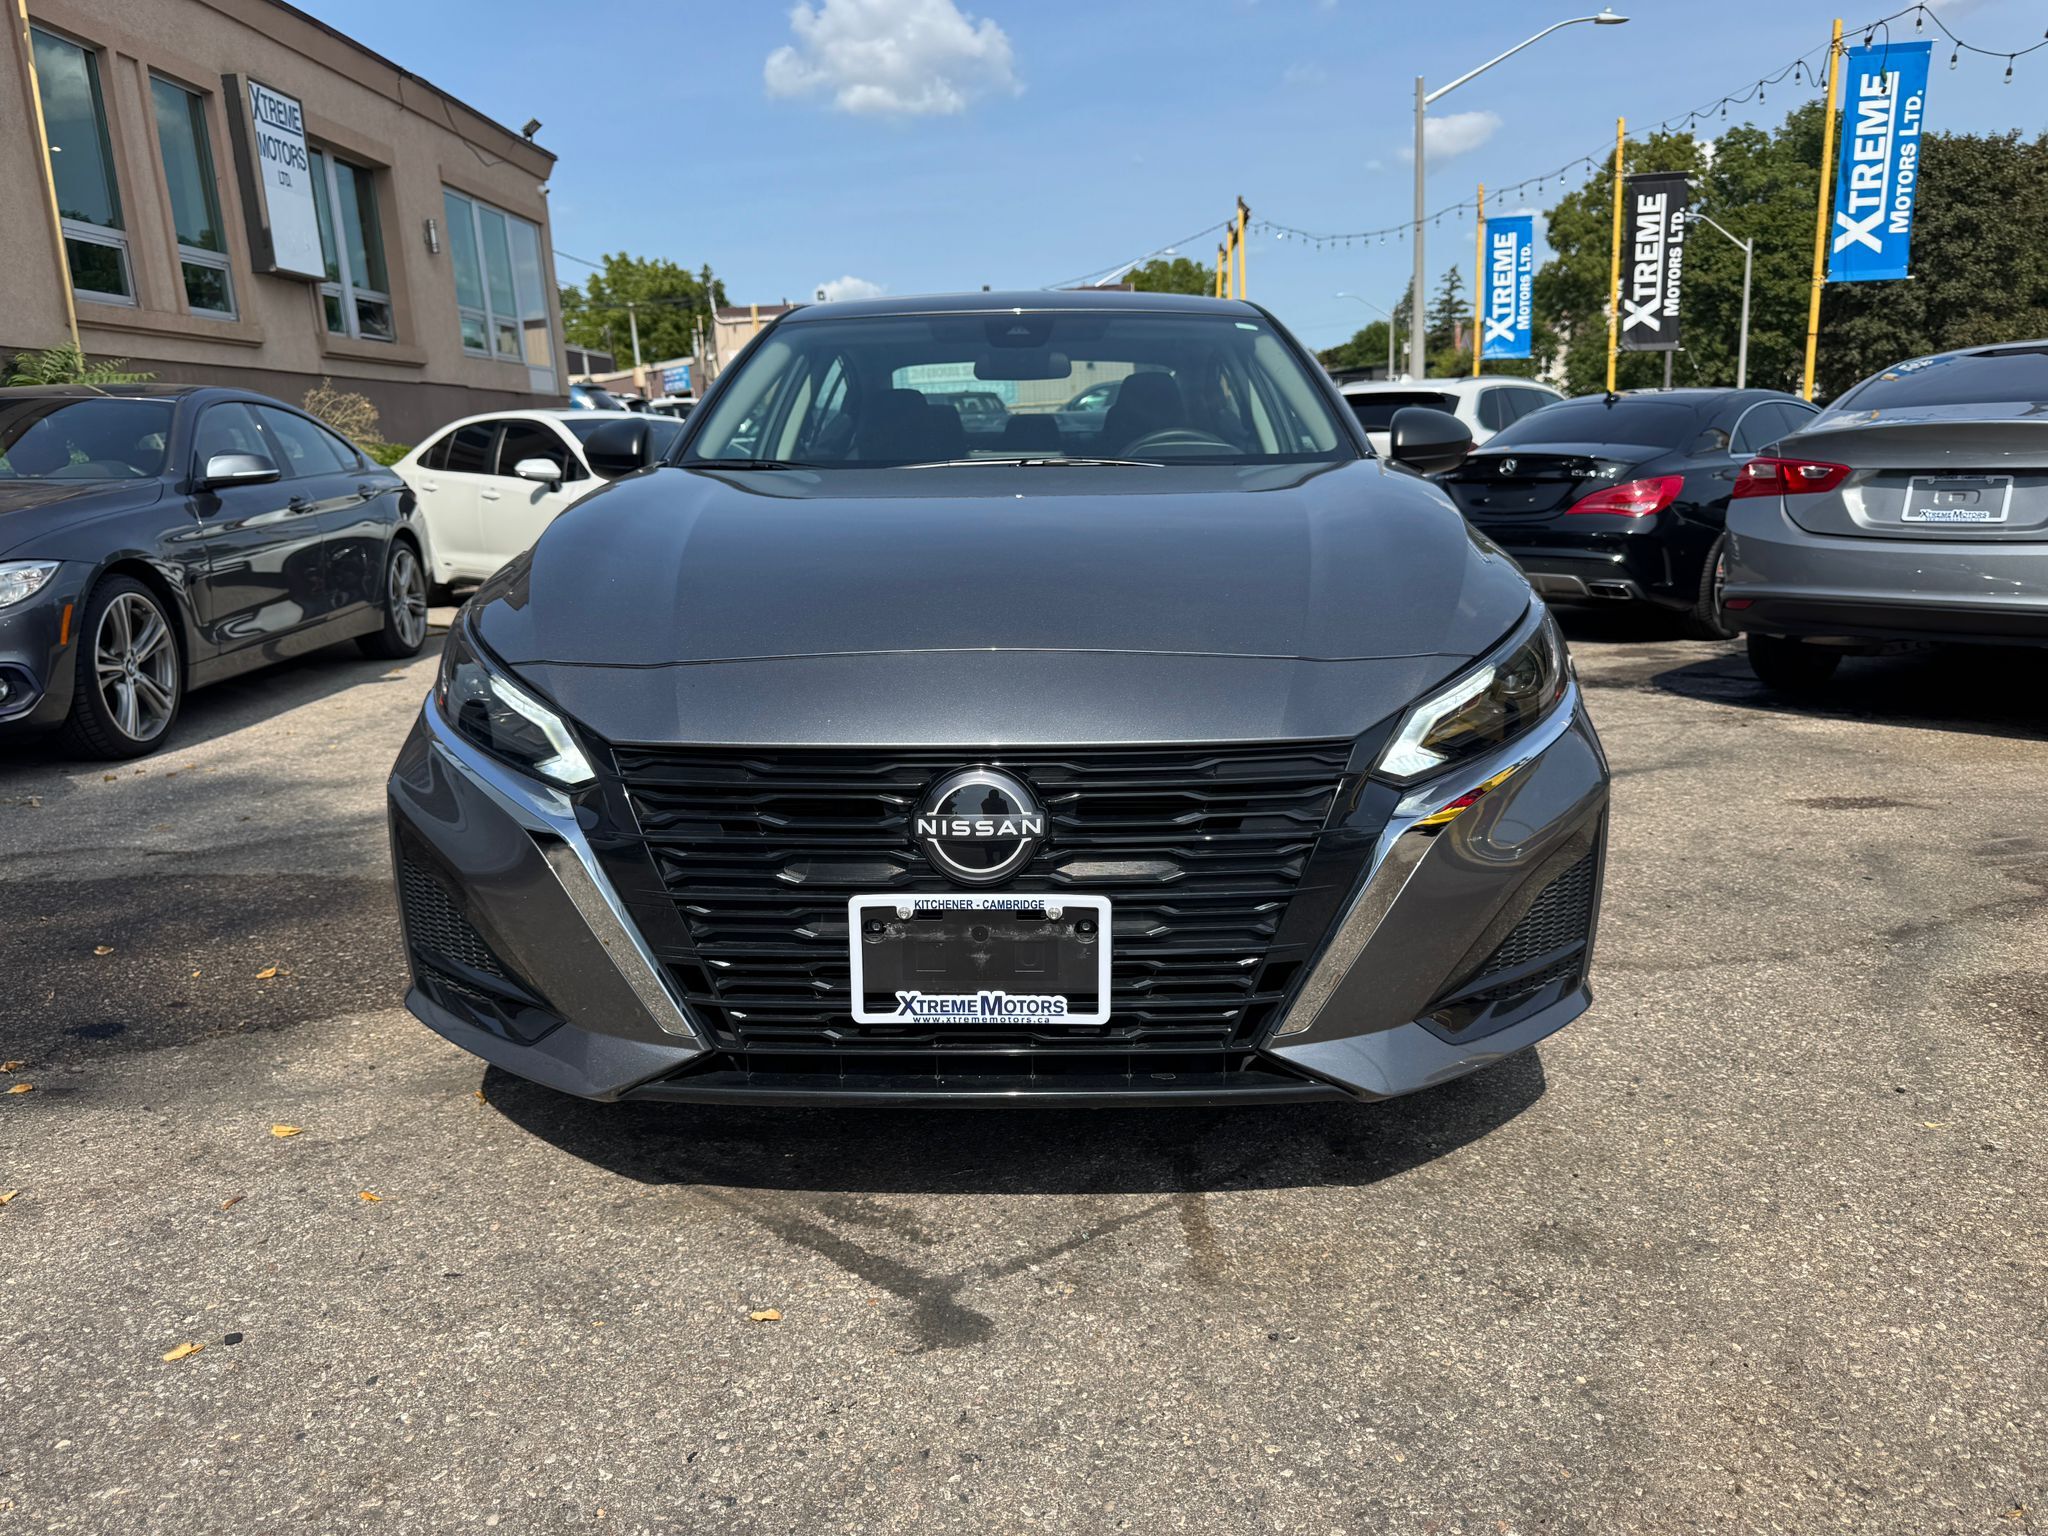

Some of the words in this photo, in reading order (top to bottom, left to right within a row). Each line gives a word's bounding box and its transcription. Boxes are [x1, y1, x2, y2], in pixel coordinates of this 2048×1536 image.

[249, 83, 303, 137] XTREME
[1899, 90, 1924, 136] LTD.
[257, 131, 307, 172] MOTORS
[1833, 71, 1900, 254] XTREME
[1888, 142, 1917, 234] MOTORS
[1667, 207, 1686, 243] LTD.
[1518, 243, 1532, 272] LTD.
[1623, 193, 1668, 332] XTREME
[1663, 247, 1683, 317] MOTORS
[1485, 231, 1517, 342] XTREME
[1516, 274, 1532, 330] MOTORS
[917, 818, 1041, 836] NISSAN
[914, 899, 974, 910] KITCHENER
[982, 899, 1045, 910] CAMBRIDGE
[912, 1015, 1050, 1024] www.xtrememotors.ca
